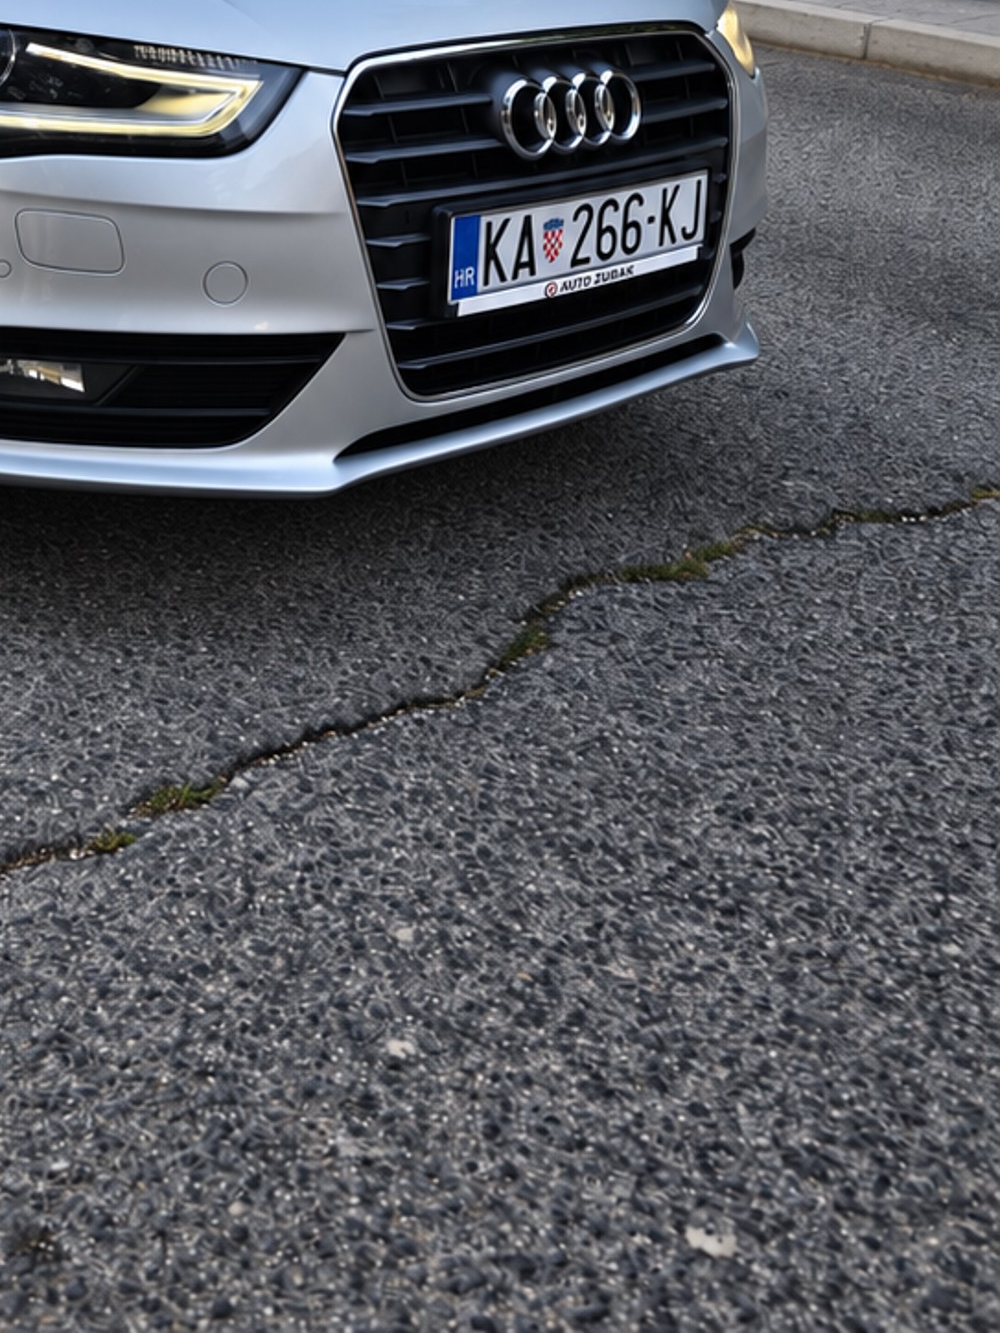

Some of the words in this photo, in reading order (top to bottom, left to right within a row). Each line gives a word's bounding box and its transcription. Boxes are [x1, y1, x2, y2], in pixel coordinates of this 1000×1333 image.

[483, 215, 536, 287] KA
[570, 179, 702, 268] 266-KJ
[454, 266, 476, 289] HR
[560, 275, 592, 293] AUTO
